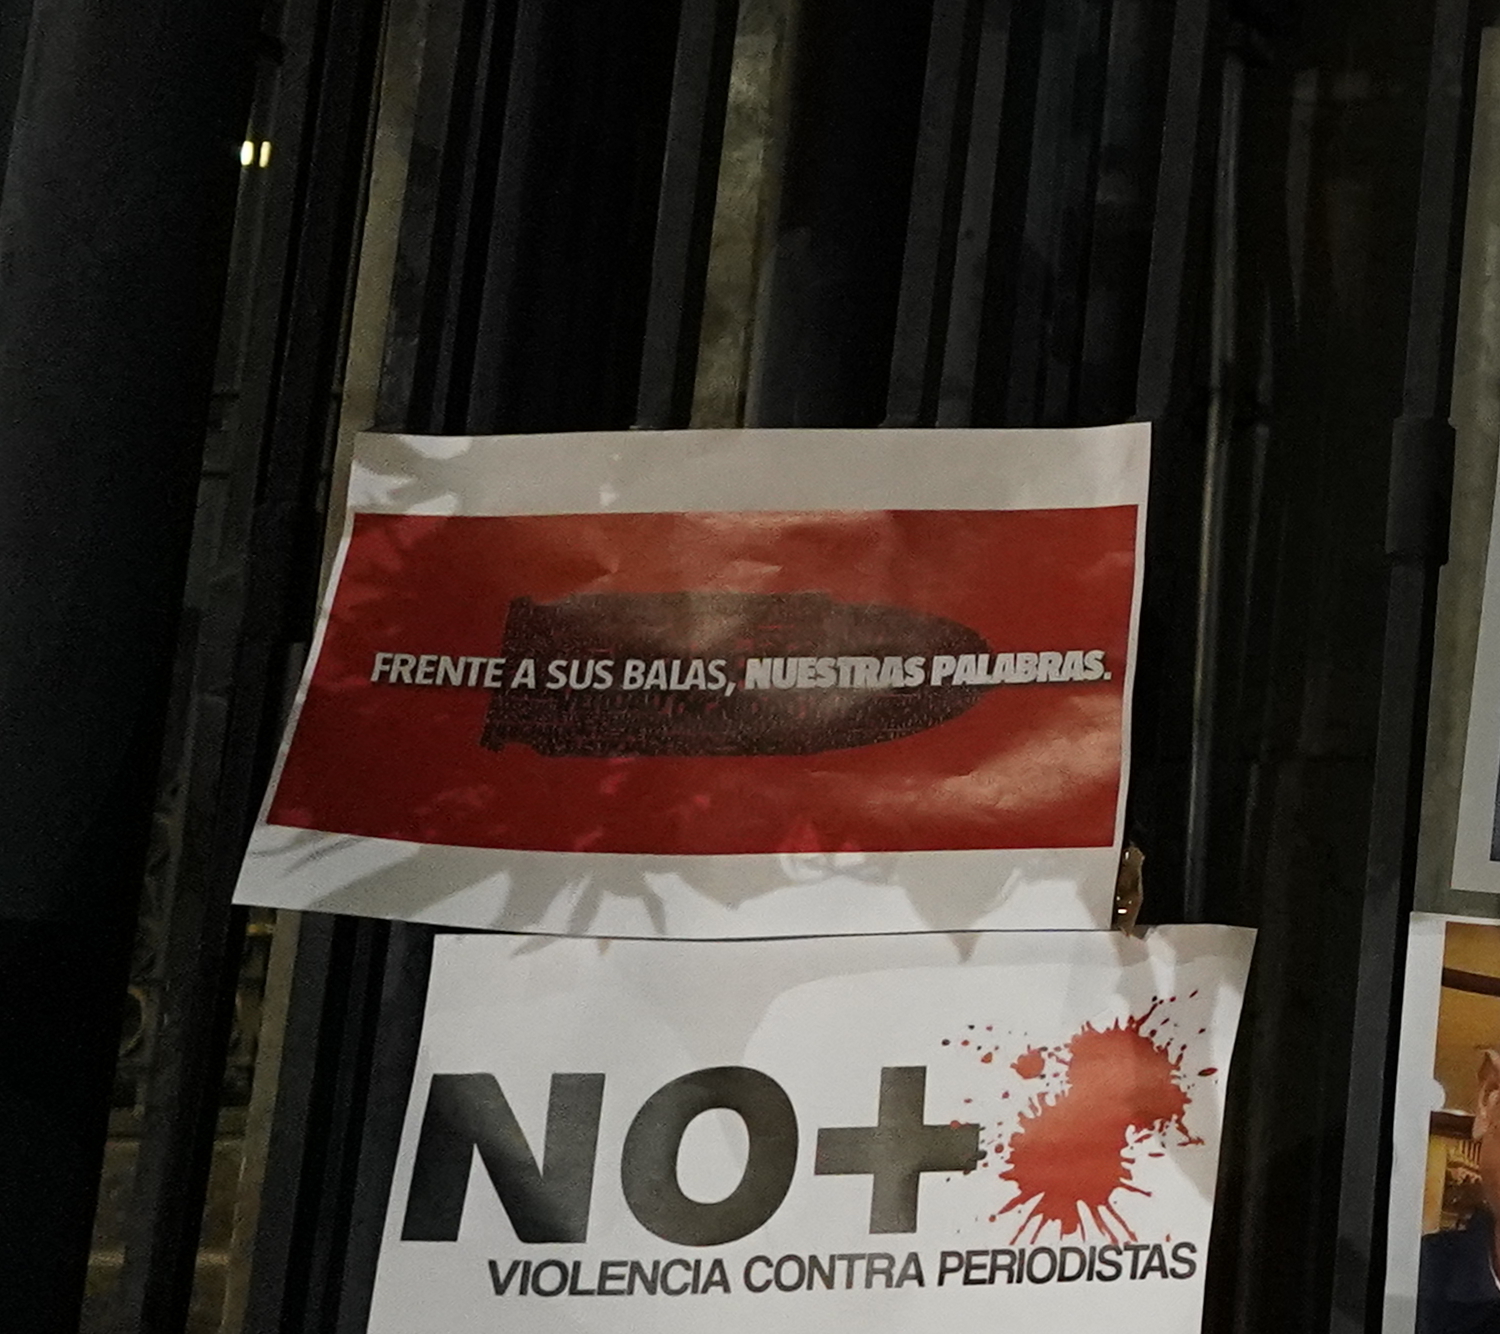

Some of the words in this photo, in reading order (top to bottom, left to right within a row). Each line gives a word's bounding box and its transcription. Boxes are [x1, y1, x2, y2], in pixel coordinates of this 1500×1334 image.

[371, 652, 507, 688] FRENTE
[510, 658, 537, 689] A
[546, 659, 614, 690] SUS
[622, 658, 737, 697] BALAS,
[744, 656, 927, 691] NUESTRAS
[930, 649, 1112, 687] PALABRAS.
[486, 1257, 731, 1297] VIOLENCIA
[743, 1251, 926, 1293] CONTRA
[937, 1241, 1198, 1287] PERIODISTAS
